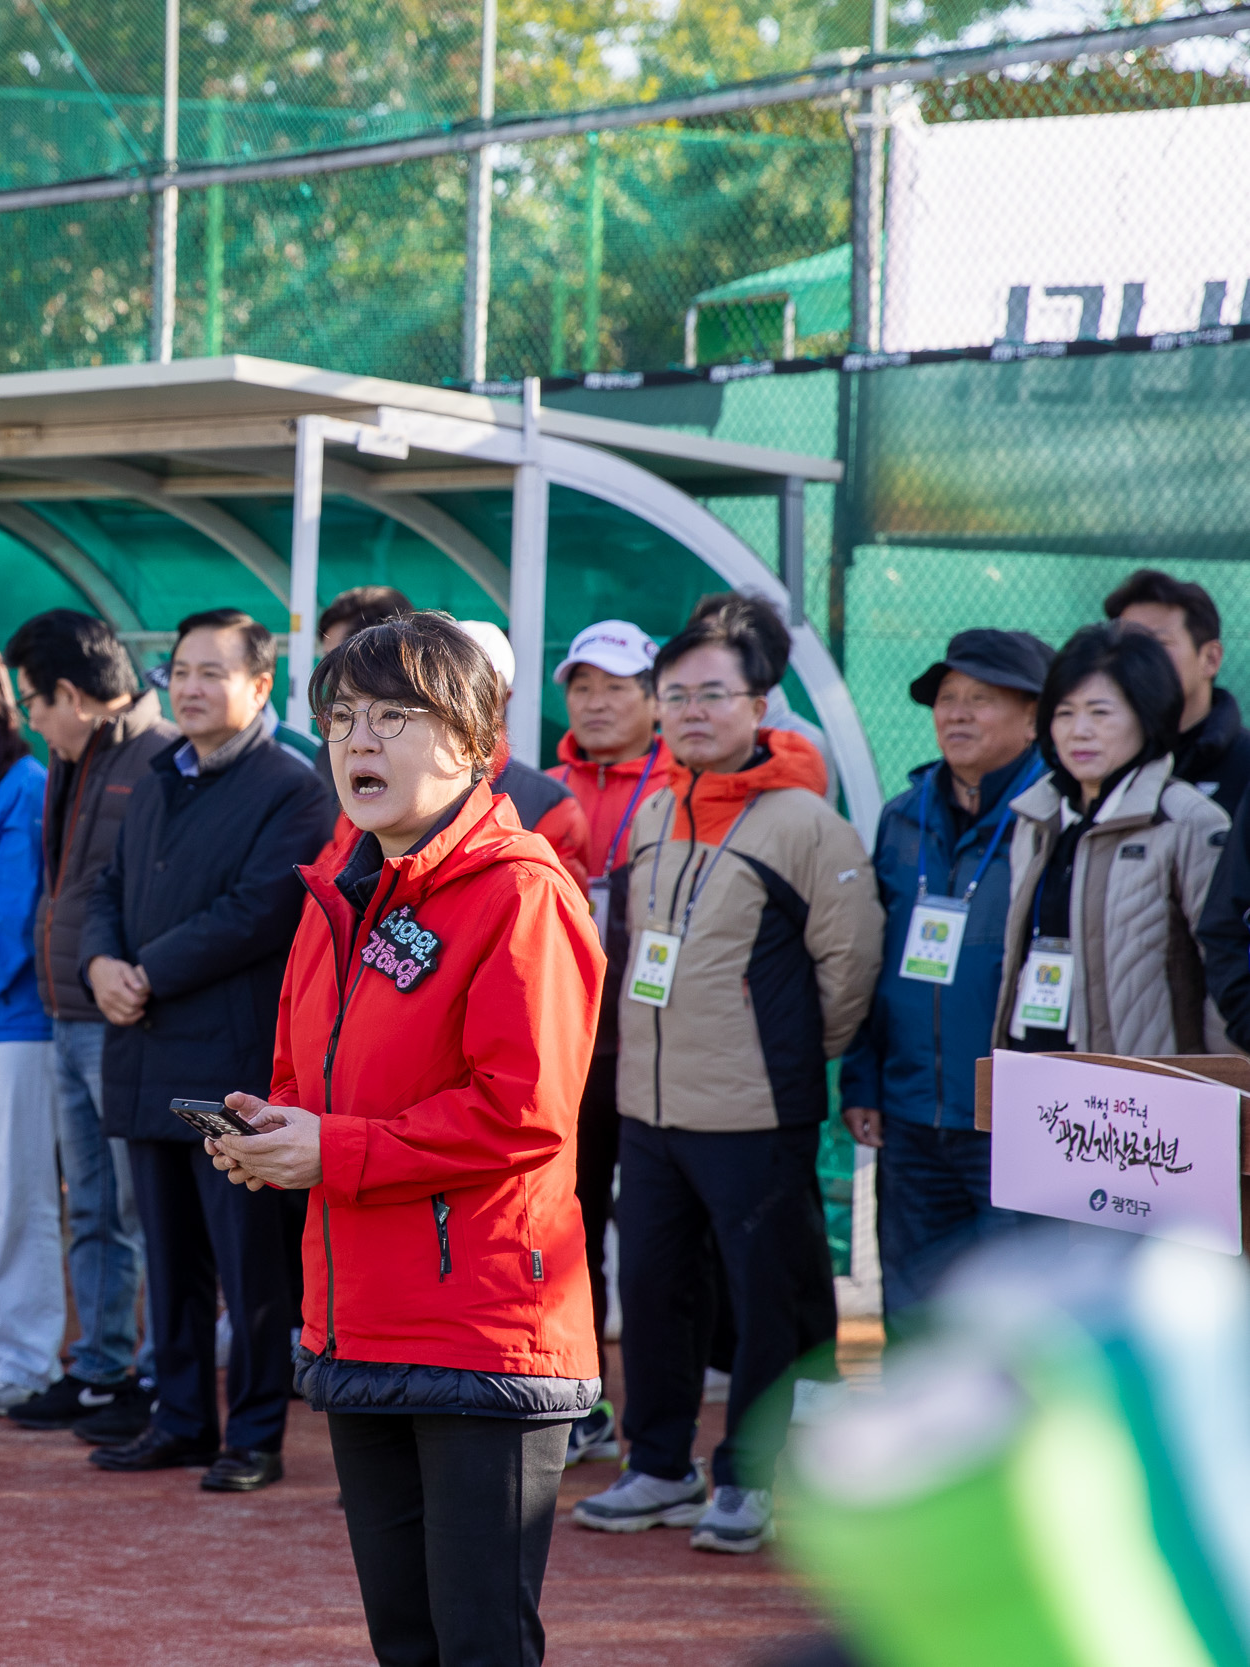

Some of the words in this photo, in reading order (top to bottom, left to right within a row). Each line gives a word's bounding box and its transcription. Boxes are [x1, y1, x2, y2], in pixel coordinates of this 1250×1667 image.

[380, 910, 438, 960] 시의원
[361, 930, 422, 989] 김혜영
[1084, 1095, 1109, 1120] 개청
[1113, 1097, 1148, 1128] 30주년
[1111, 1196, 1152, 1217] 광진구
